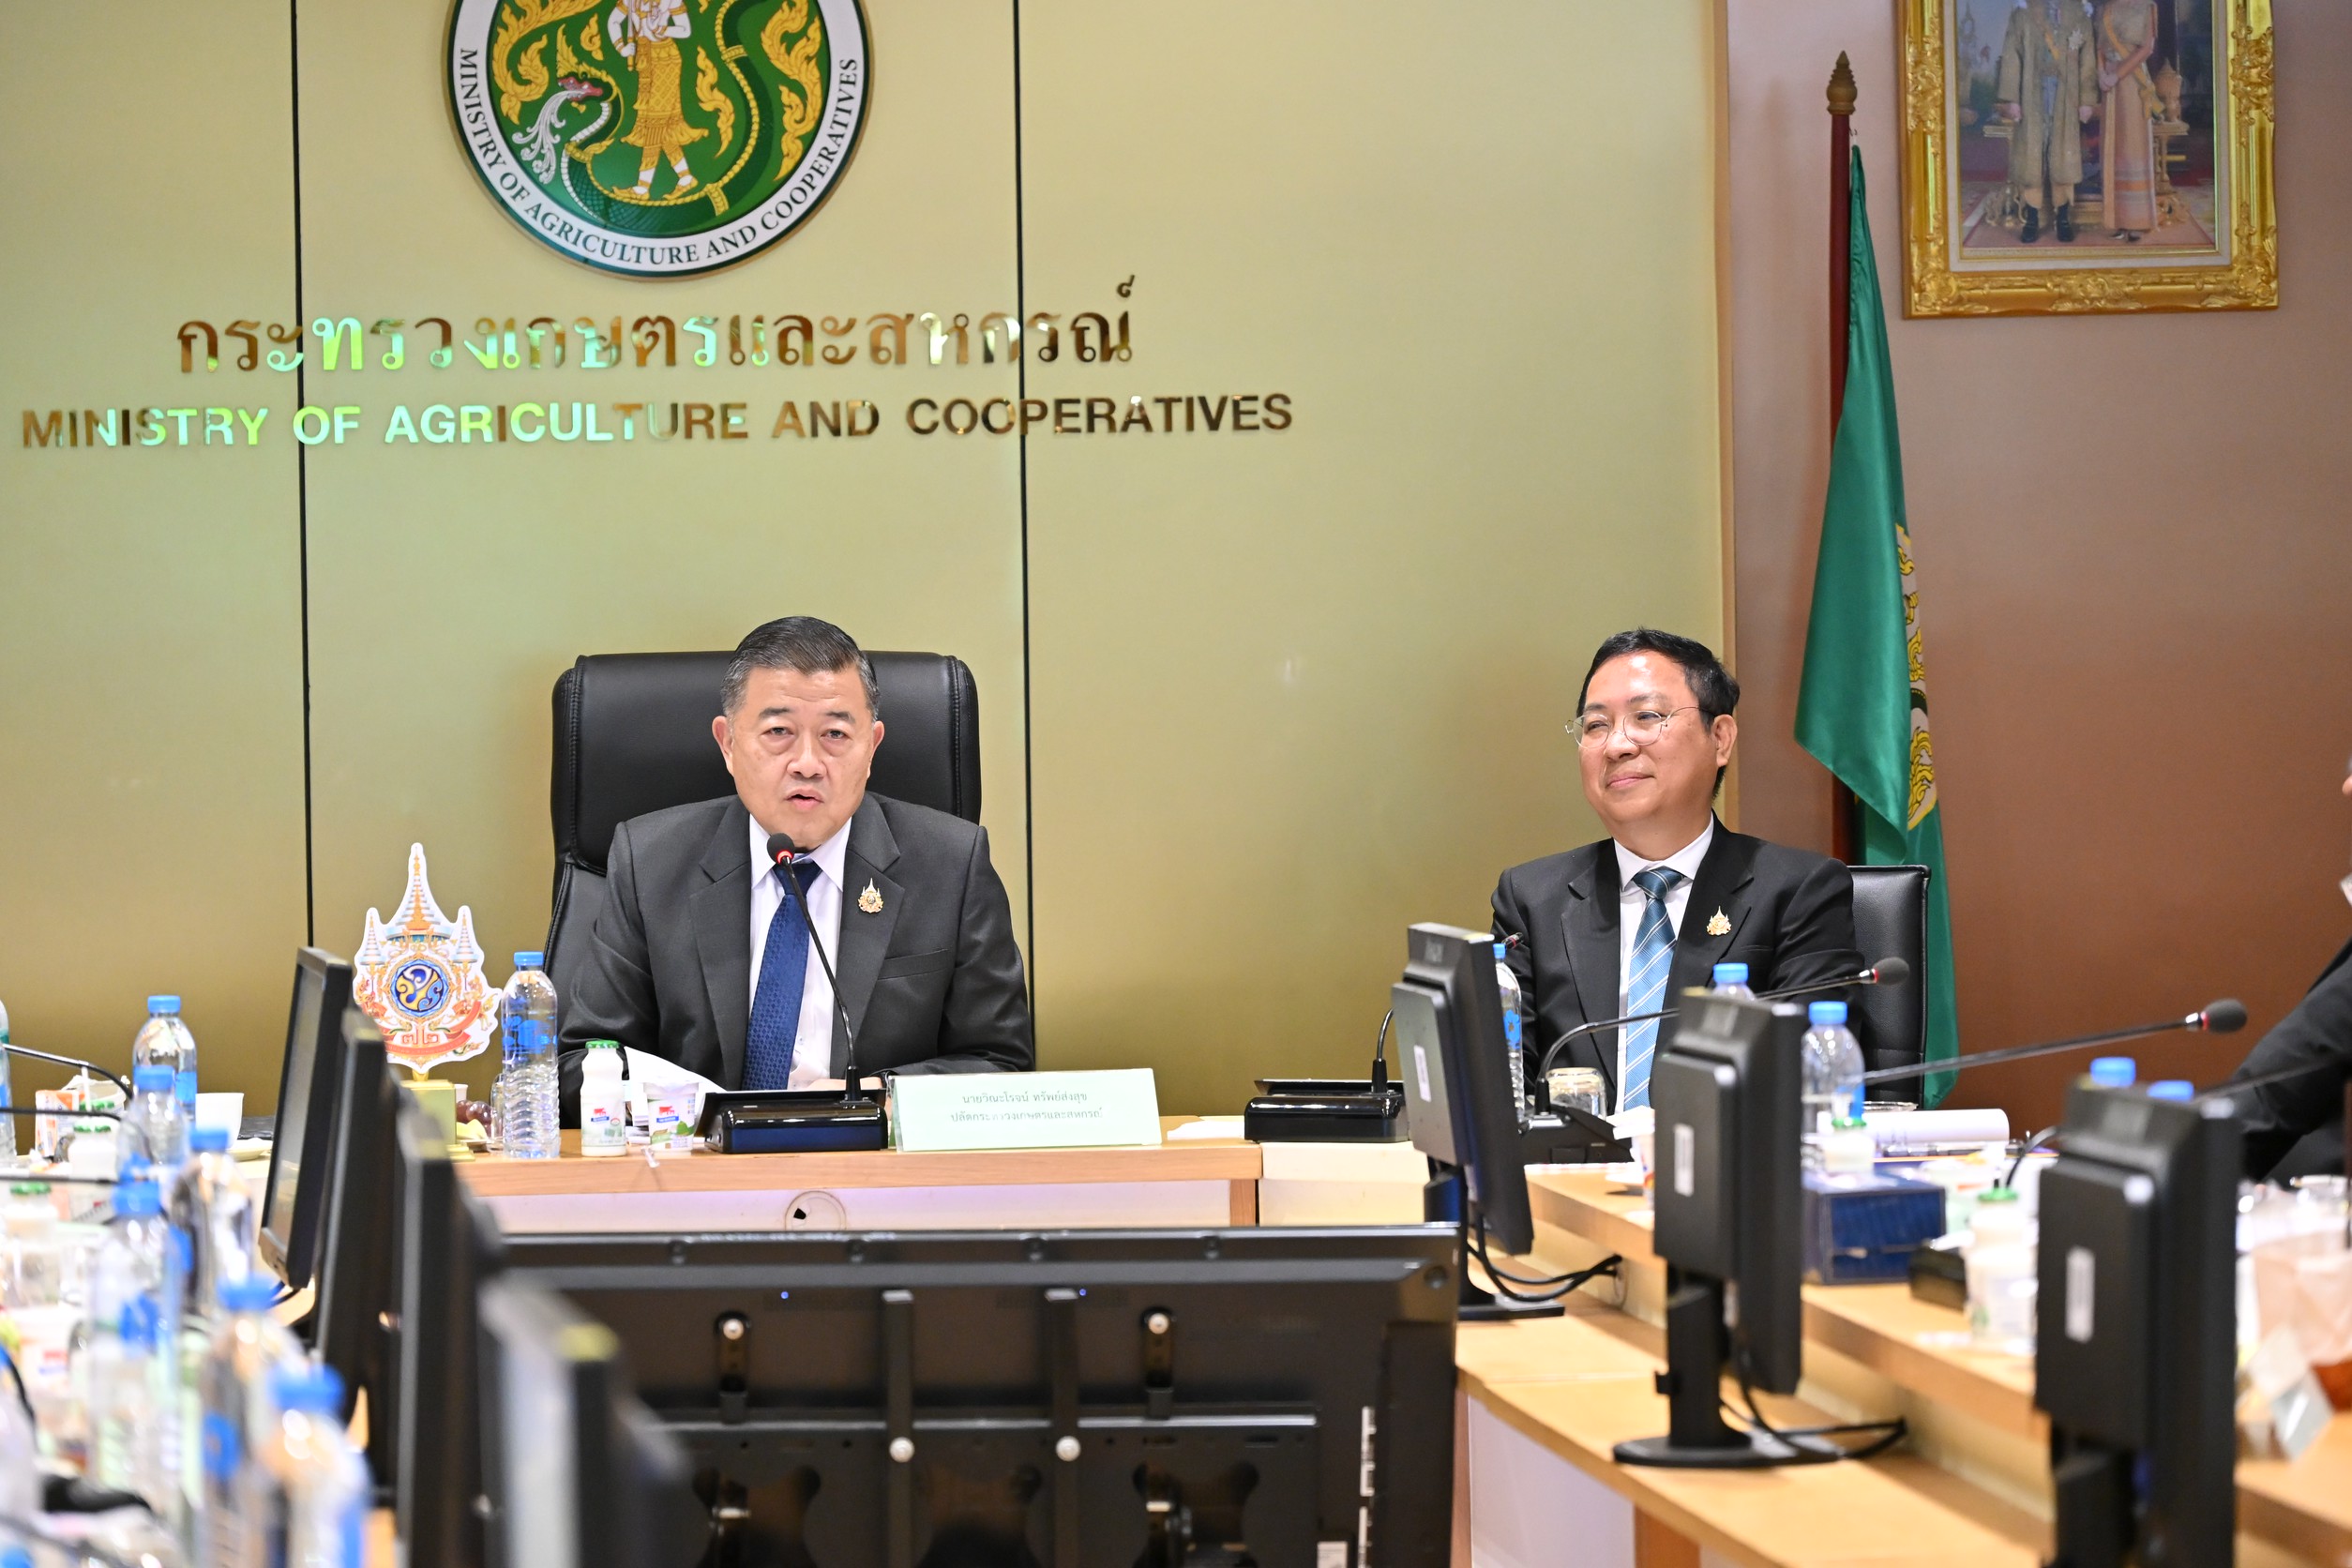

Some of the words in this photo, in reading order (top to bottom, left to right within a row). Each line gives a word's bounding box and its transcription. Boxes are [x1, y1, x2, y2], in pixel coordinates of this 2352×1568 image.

[460, 48, 508, 171] MINISTRY
[499, 173, 531, 204] OF
[524, 201, 700, 265] AGRICULTURE
[706, 224, 758, 259] AND
[760, 58, 859, 231] COOPERATIVES
[175, 274, 1136, 374] กระทรวงเกษตรและสหกรณ์
[22, 406, 269, 448] MINISTRY
[292, 404, 362, 446] OF
[384, 400, 749, 445] AGRICULTURE
[771, 400, 881, 440] AND
[905, 394, 1293, 438] COOPERATIVES
